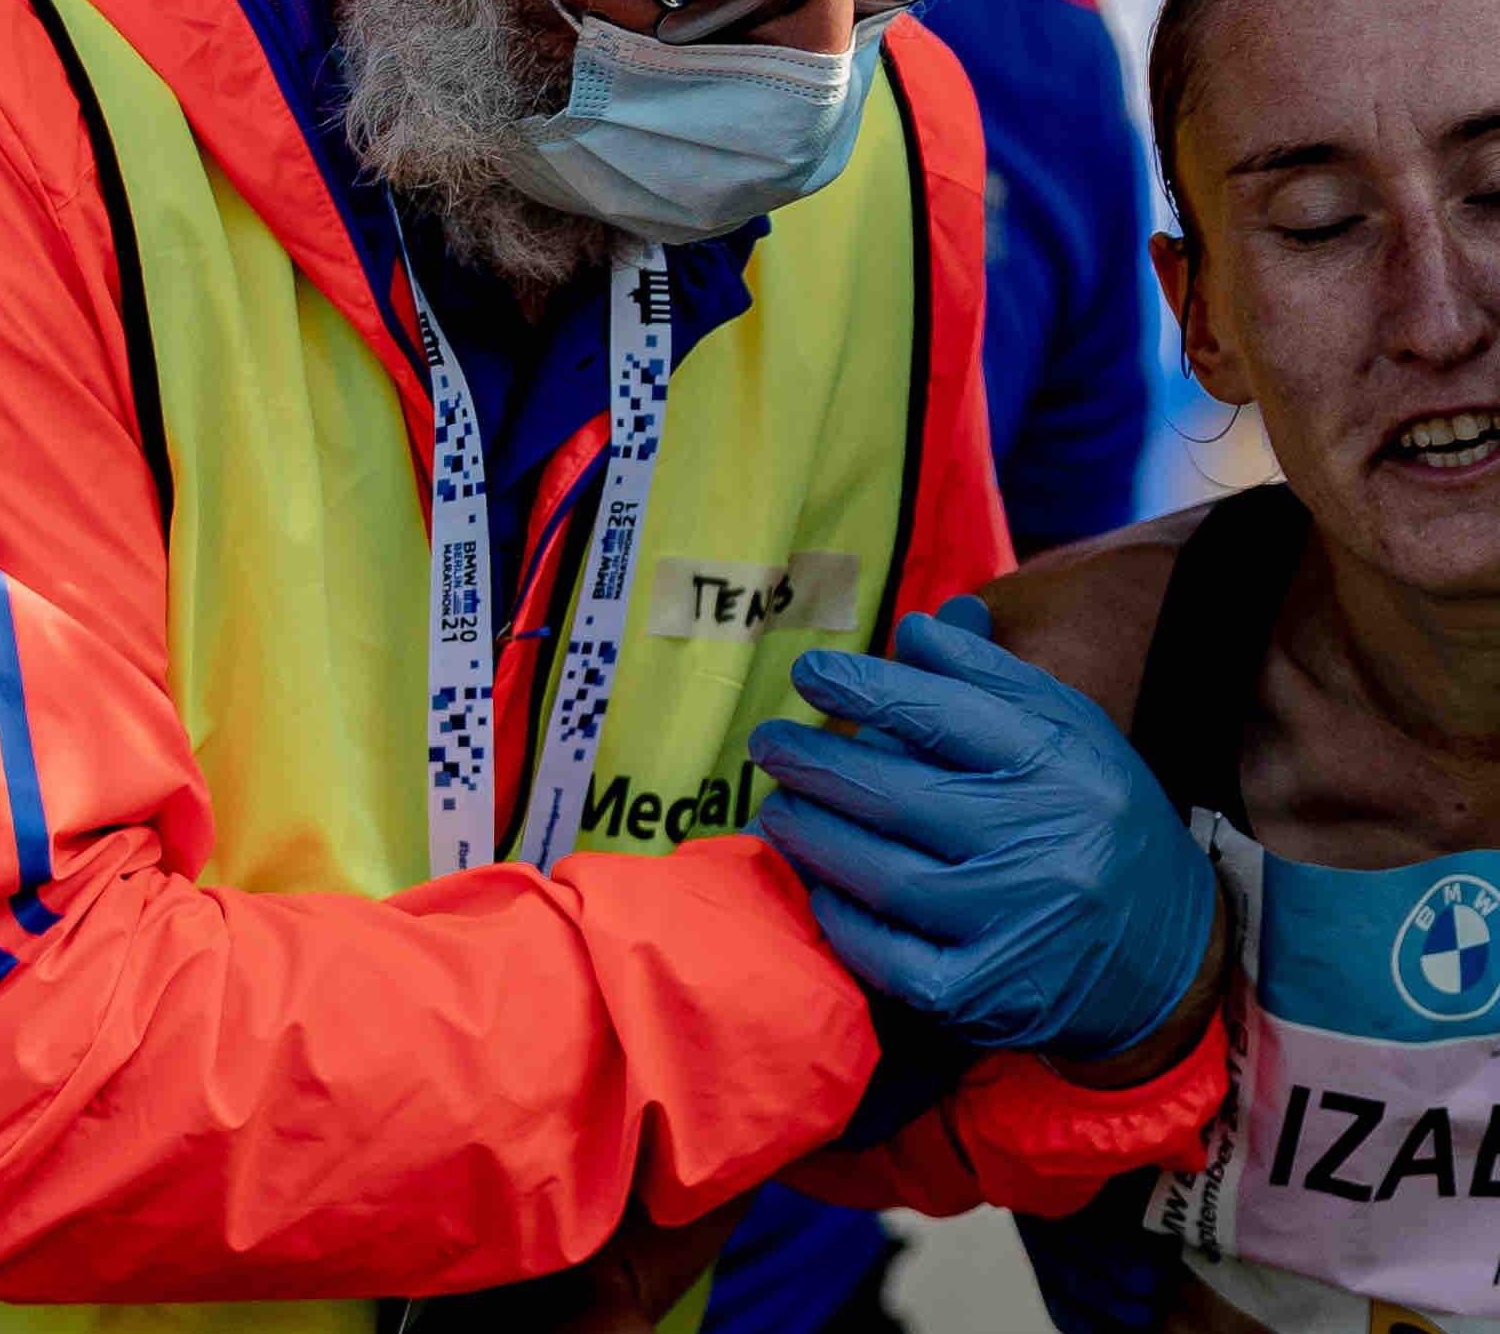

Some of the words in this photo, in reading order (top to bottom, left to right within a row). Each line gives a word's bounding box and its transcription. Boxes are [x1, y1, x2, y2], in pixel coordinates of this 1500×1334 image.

[623, 503, 639, 527] 21
[463, 540, 477, 586] BMW
[592, 554, 613, 600] BMW
[607, 501, 624, 527] 20
[443, 544, 453, 615] MARATHON
[442, 618, 459, 643] 21
[460, 616, 477, 643] 20
[1415, 882, 1499, 931] BMW
